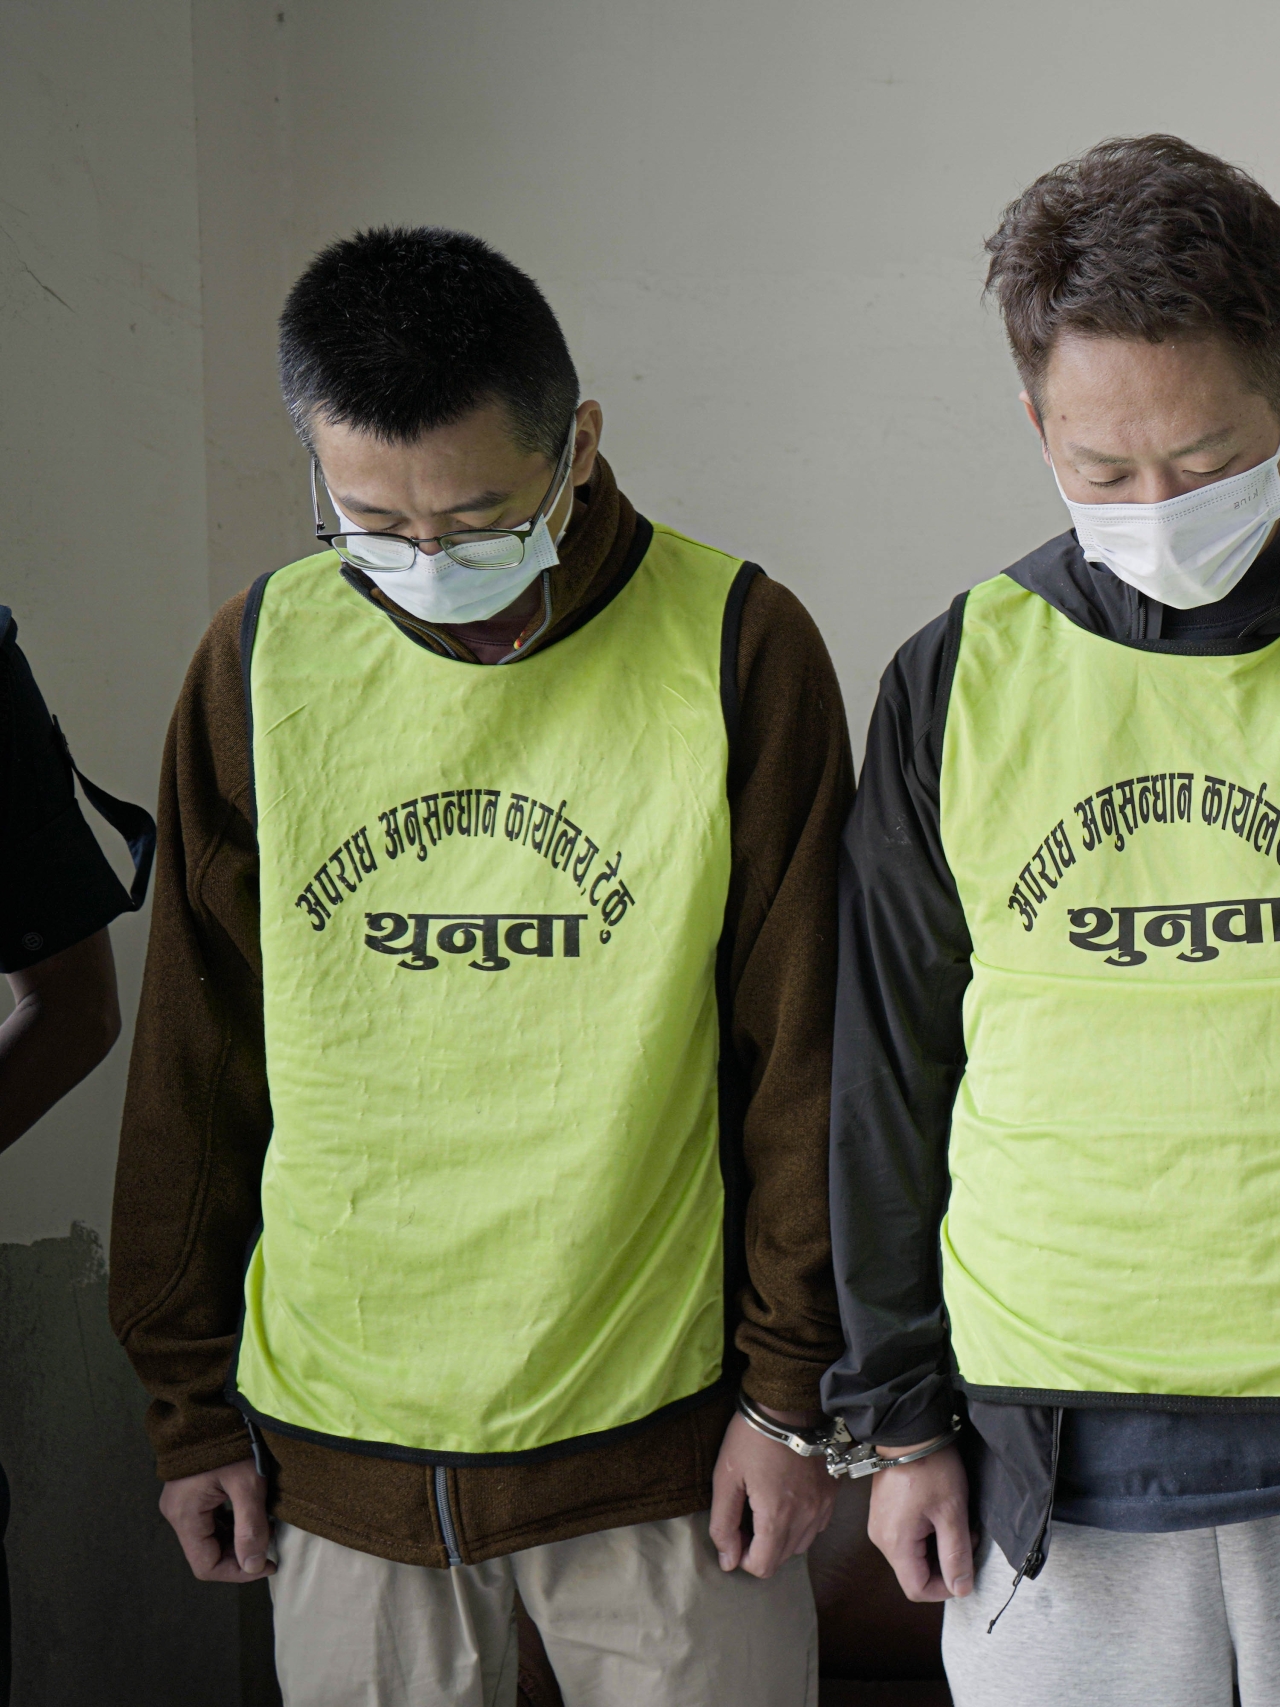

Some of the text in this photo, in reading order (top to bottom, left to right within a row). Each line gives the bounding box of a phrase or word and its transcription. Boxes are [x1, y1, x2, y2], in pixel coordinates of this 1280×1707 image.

[295, 826, 378, 932] अपराध
[378, 789, 501, 862] अनुसन्धान
[1008, 819, 1077, 932] अपराध
[1073, 773, 1194, 853] अनुसन्धान
[364, 912, 589, 972] थुनुवा
